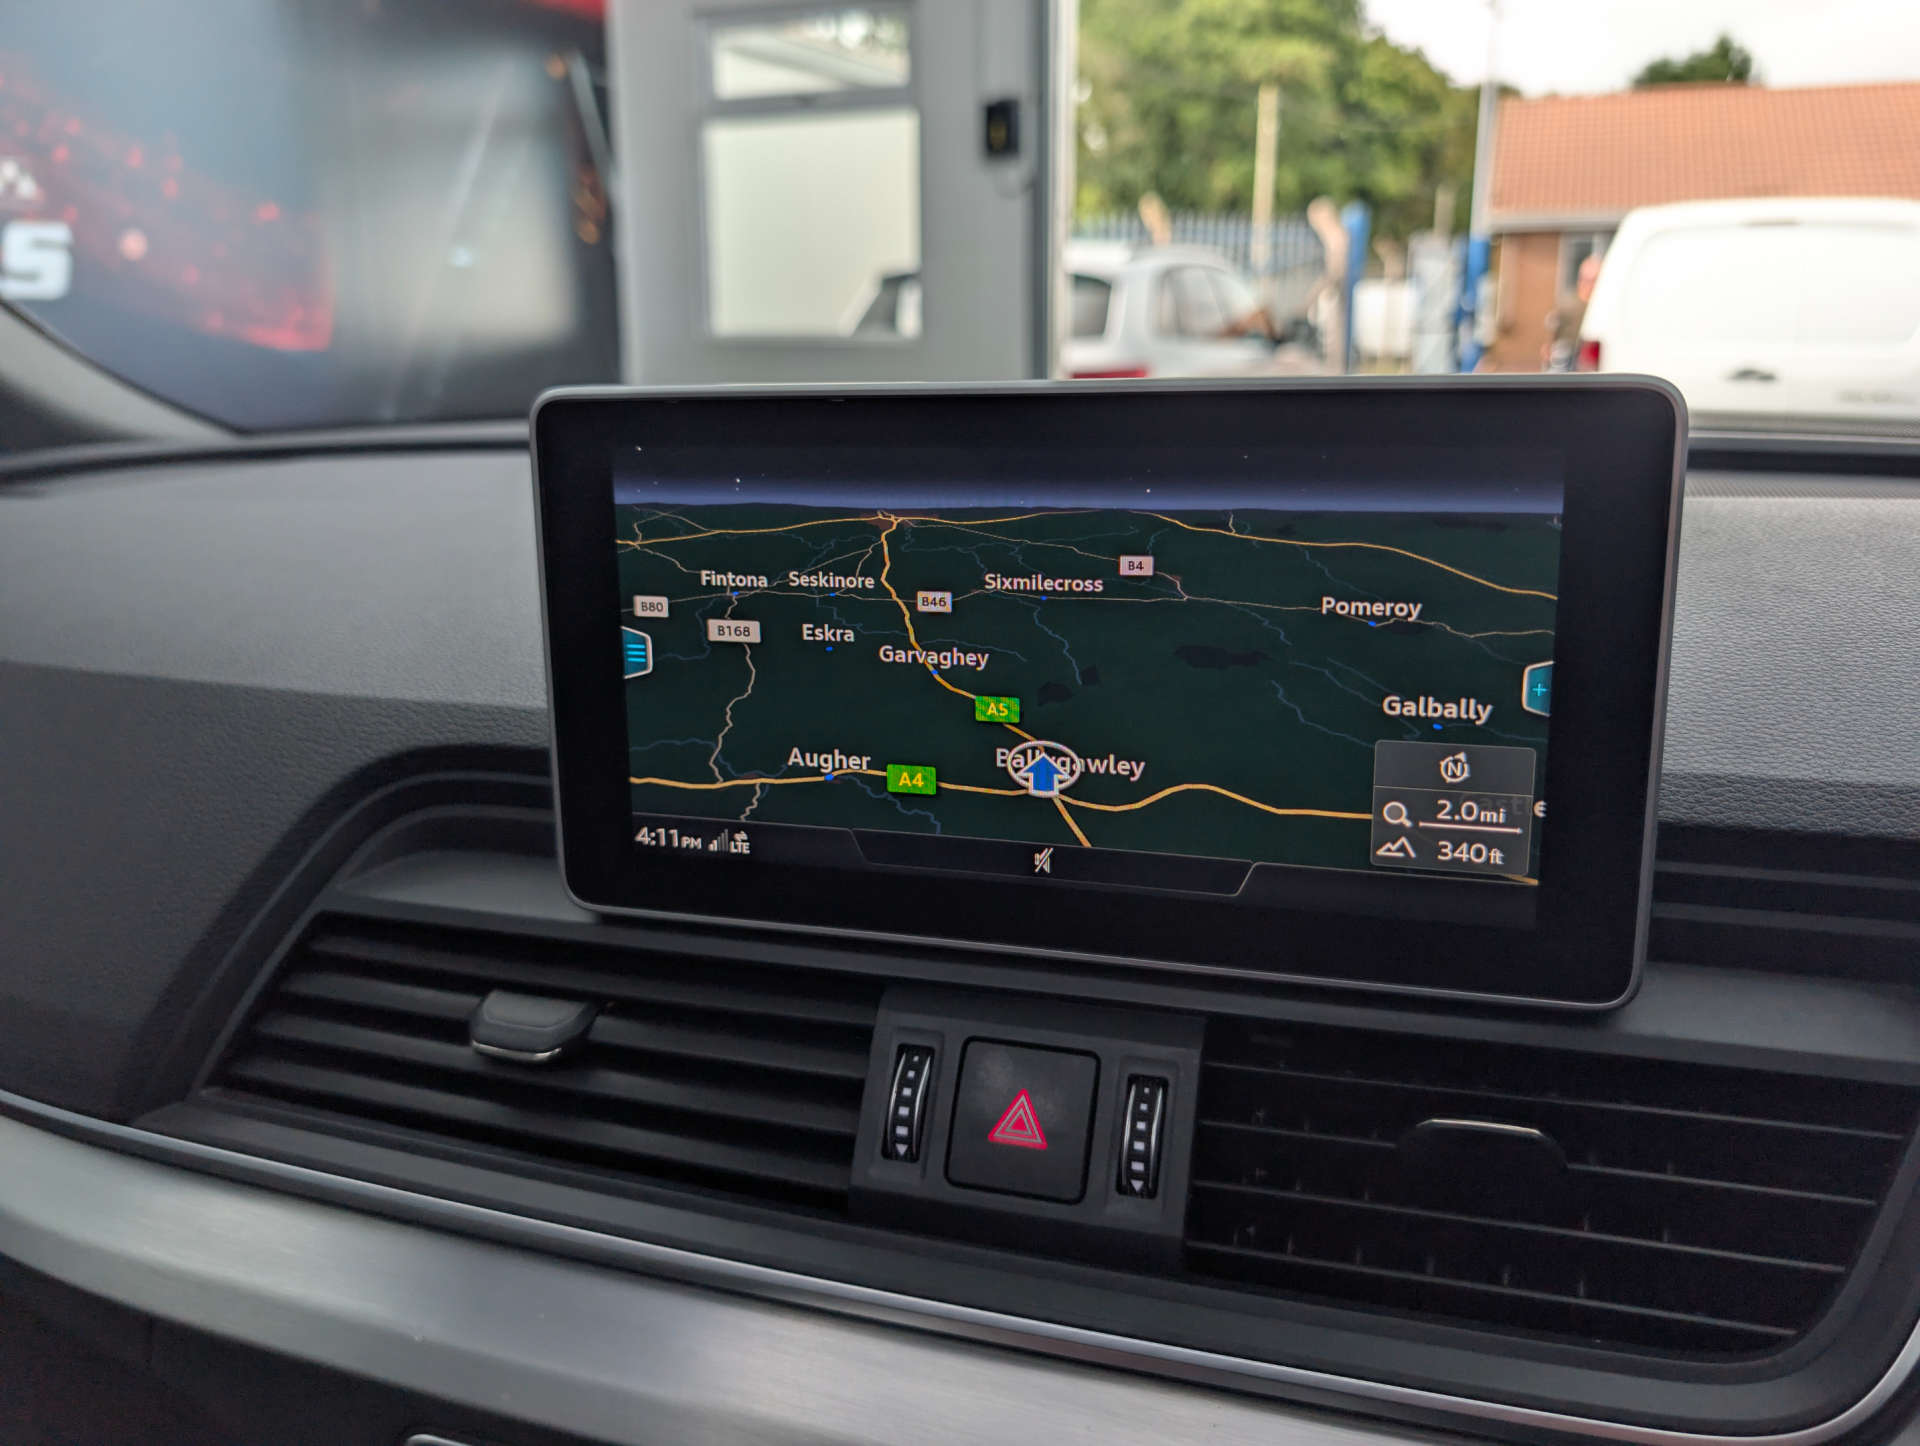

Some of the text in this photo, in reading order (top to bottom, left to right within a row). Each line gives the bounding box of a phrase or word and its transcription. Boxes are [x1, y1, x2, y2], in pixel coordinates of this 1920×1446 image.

[1127, 560, 1144, 571] B4
[700, 570, 768, 588] Fintona
[788, 571, 875, 589] Seskinore
[984, 573, 1104, 592] Sixmilecross
[641, 601, 664, 612] B80
[921, 596, 947, 608] B46
[1321, 596, 1423, 621] Pomeroy
[717, 624, 751, 637] B168
[802, 623, 855, 642] Eskra
[879, 645, 989, 670] Garvaghey
[986, 702, 1009, 716] A5
[1382, 695, 1493, 725] Galbally
[787, 747, 871, 774] Augher
[996, 748, 1146, 782] Ballgawley
[898, 772, 925, 788] A4
[730, 840, 750, 854] LTE
